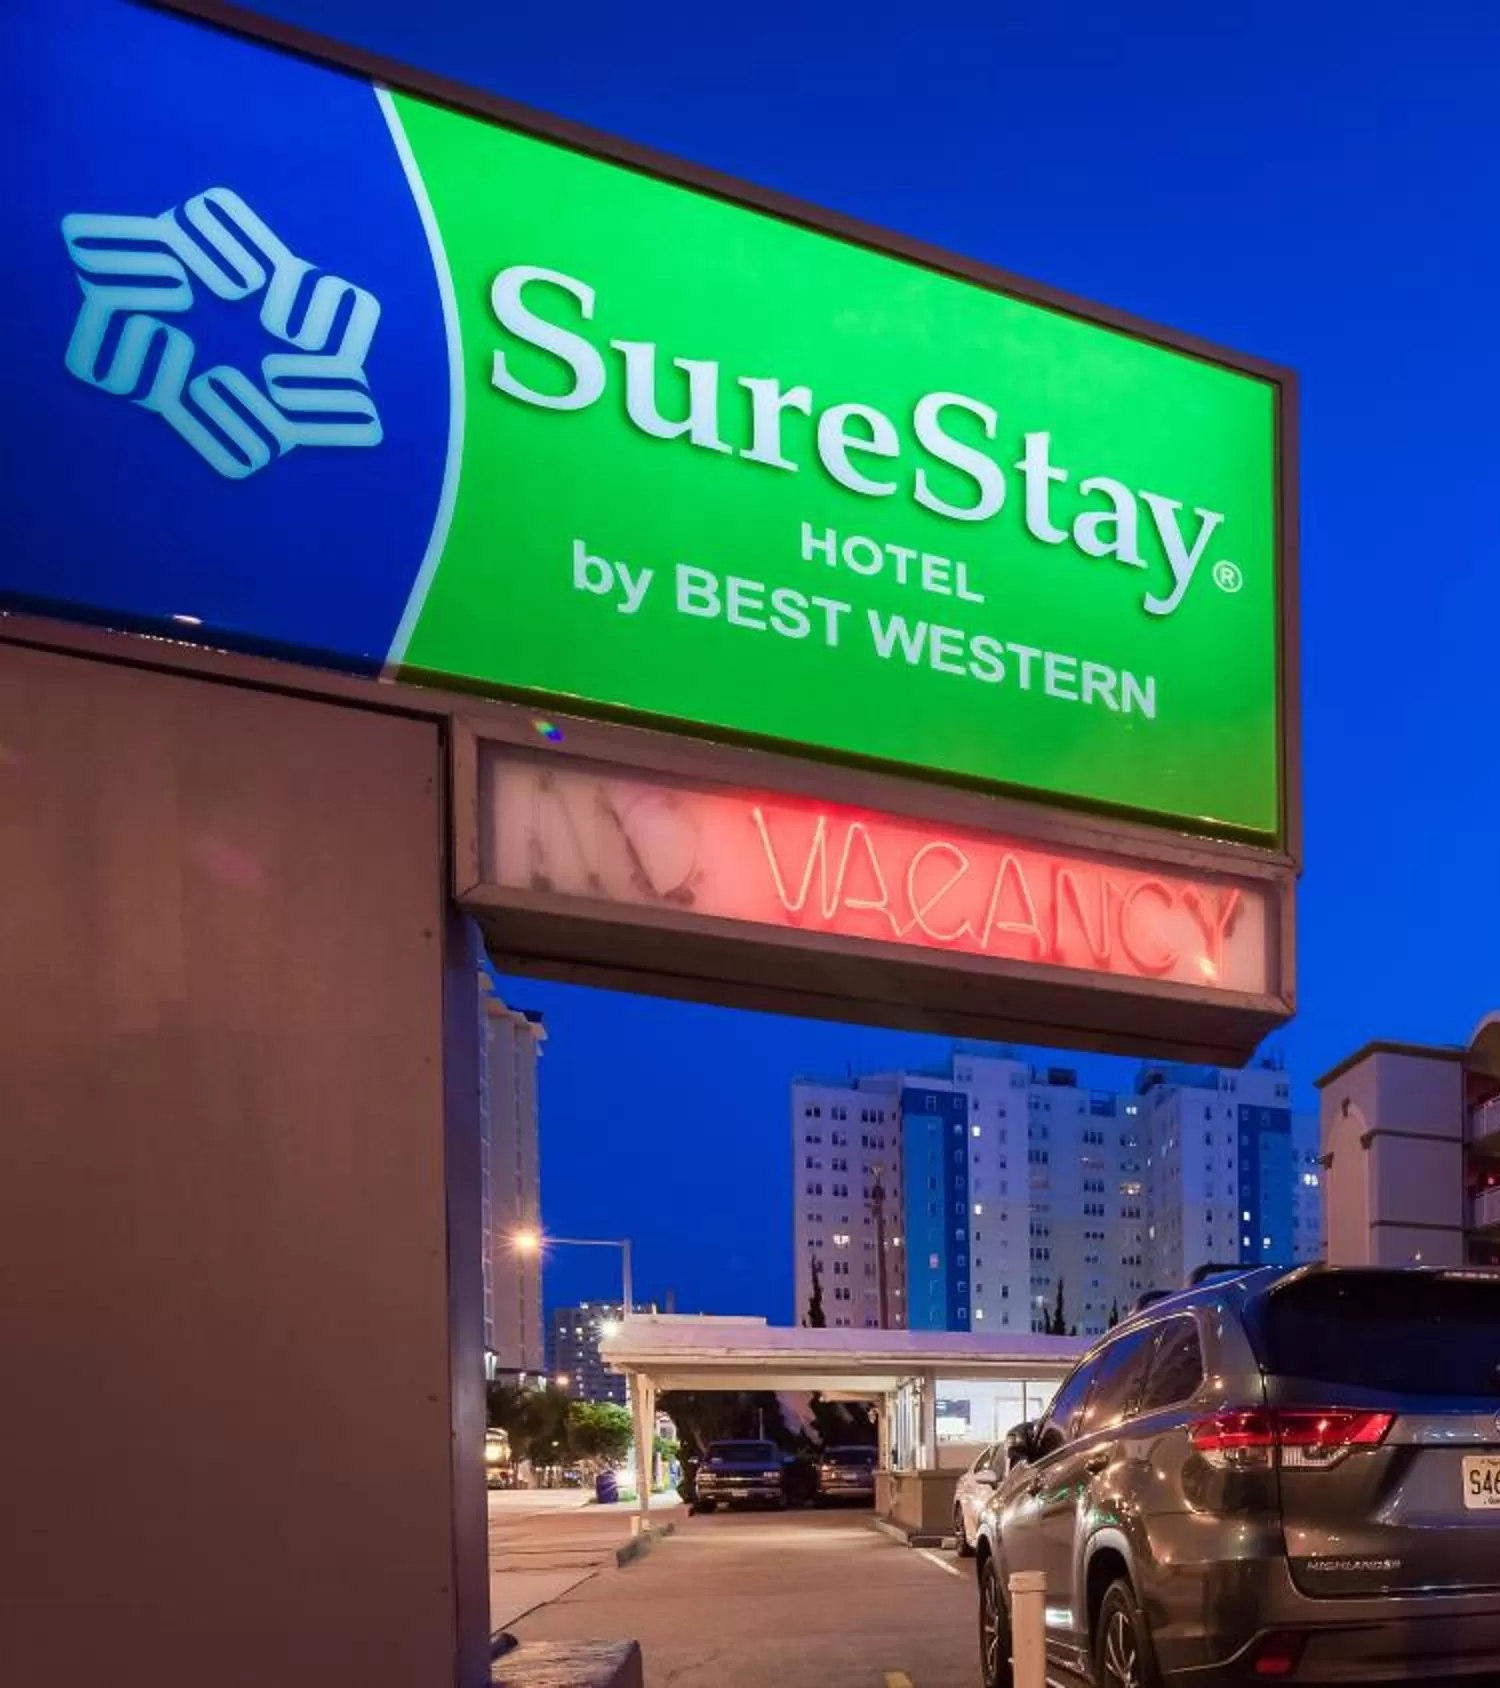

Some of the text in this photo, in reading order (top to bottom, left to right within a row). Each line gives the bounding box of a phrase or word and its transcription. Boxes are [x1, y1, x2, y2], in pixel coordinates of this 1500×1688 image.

[573, 539, 1157, 719] by BEST WESTERN
[800, 522, 985, 604] HOTEL
[752, 806, 1241, 984] VACANCY
